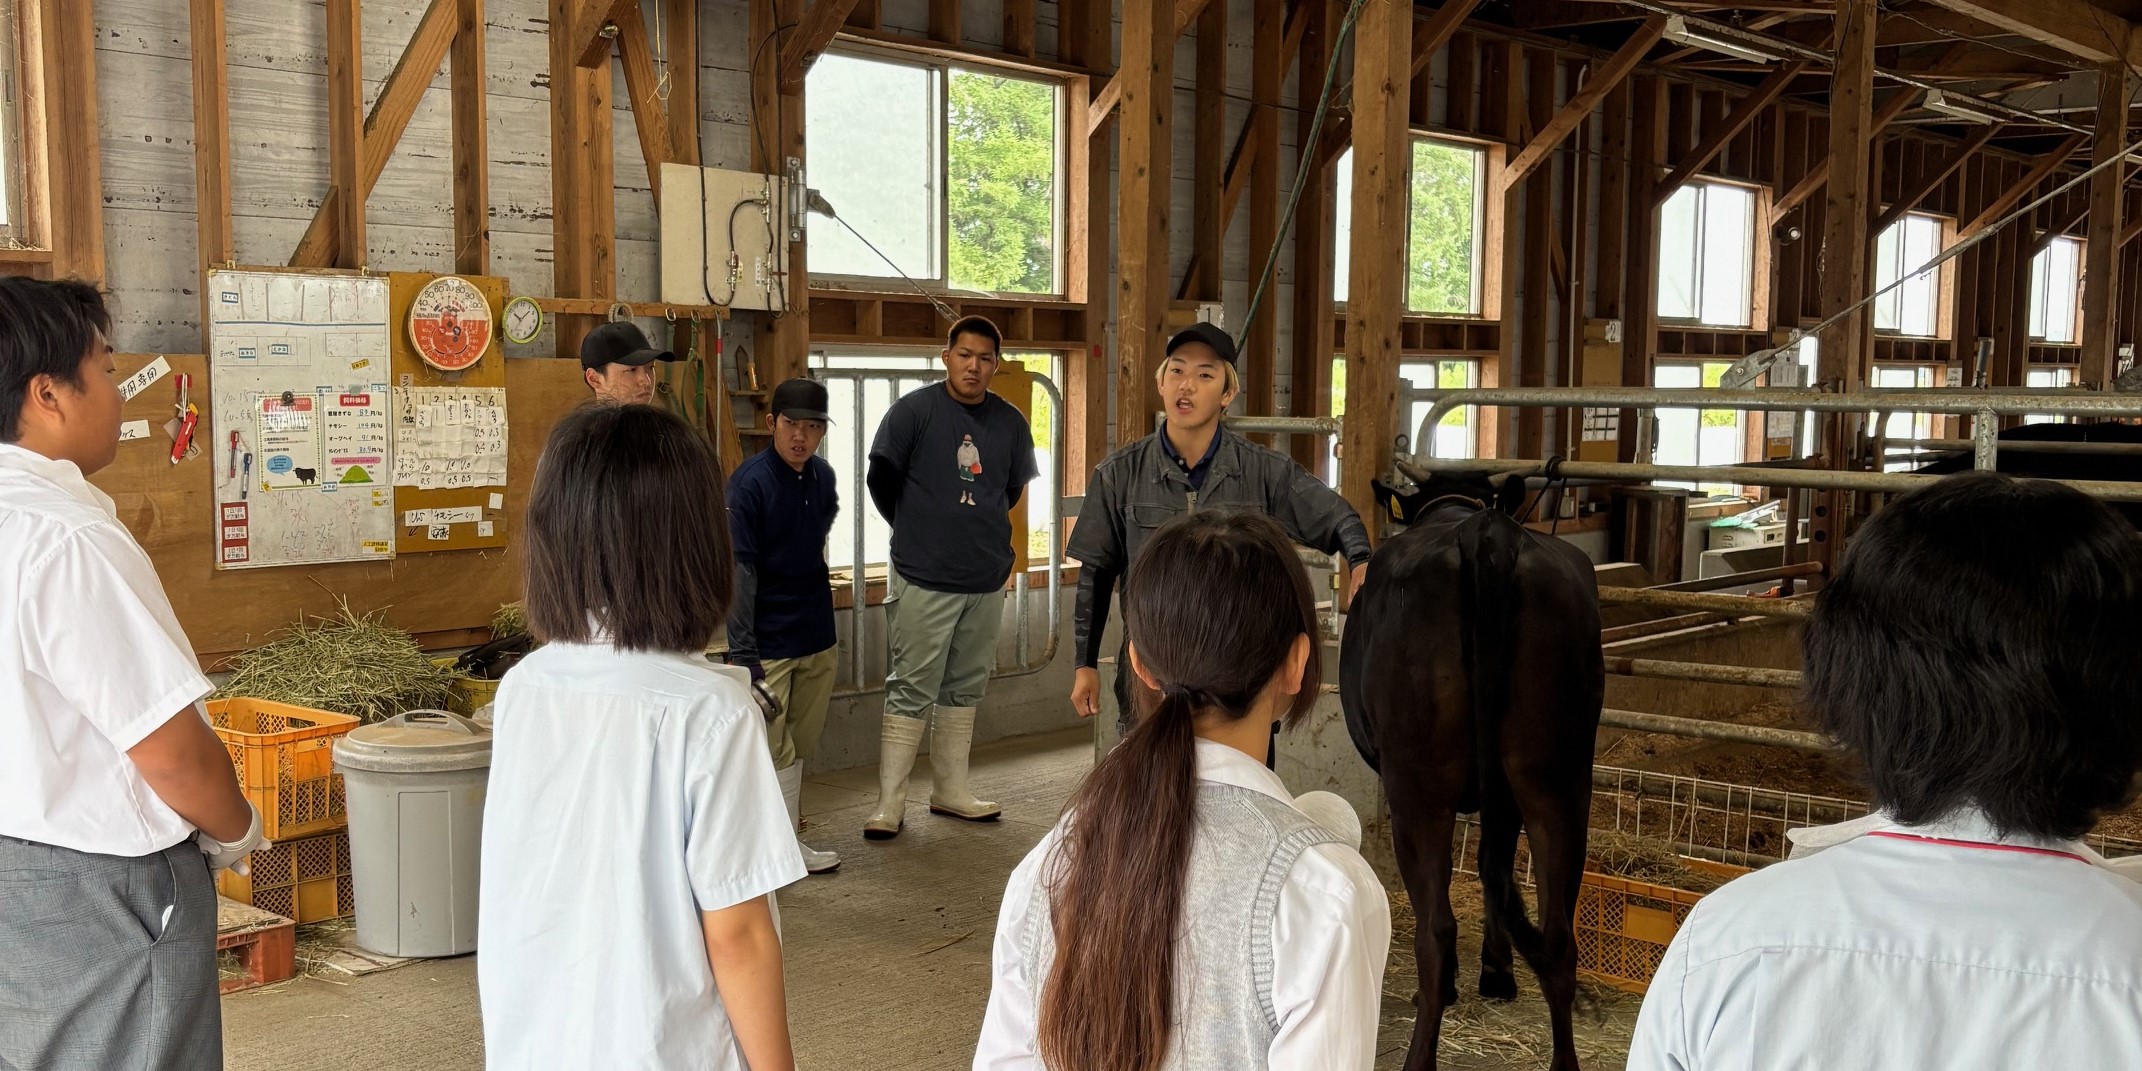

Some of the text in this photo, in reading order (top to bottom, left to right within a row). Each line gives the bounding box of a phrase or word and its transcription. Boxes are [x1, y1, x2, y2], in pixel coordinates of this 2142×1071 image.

[434, 285, 445, 293] 60
[455, 286, 466, 294] 80
[424, 291, 435, 299] 50
[475, 395, 482, 405] 5
[488, 395, 496, 407] 6
